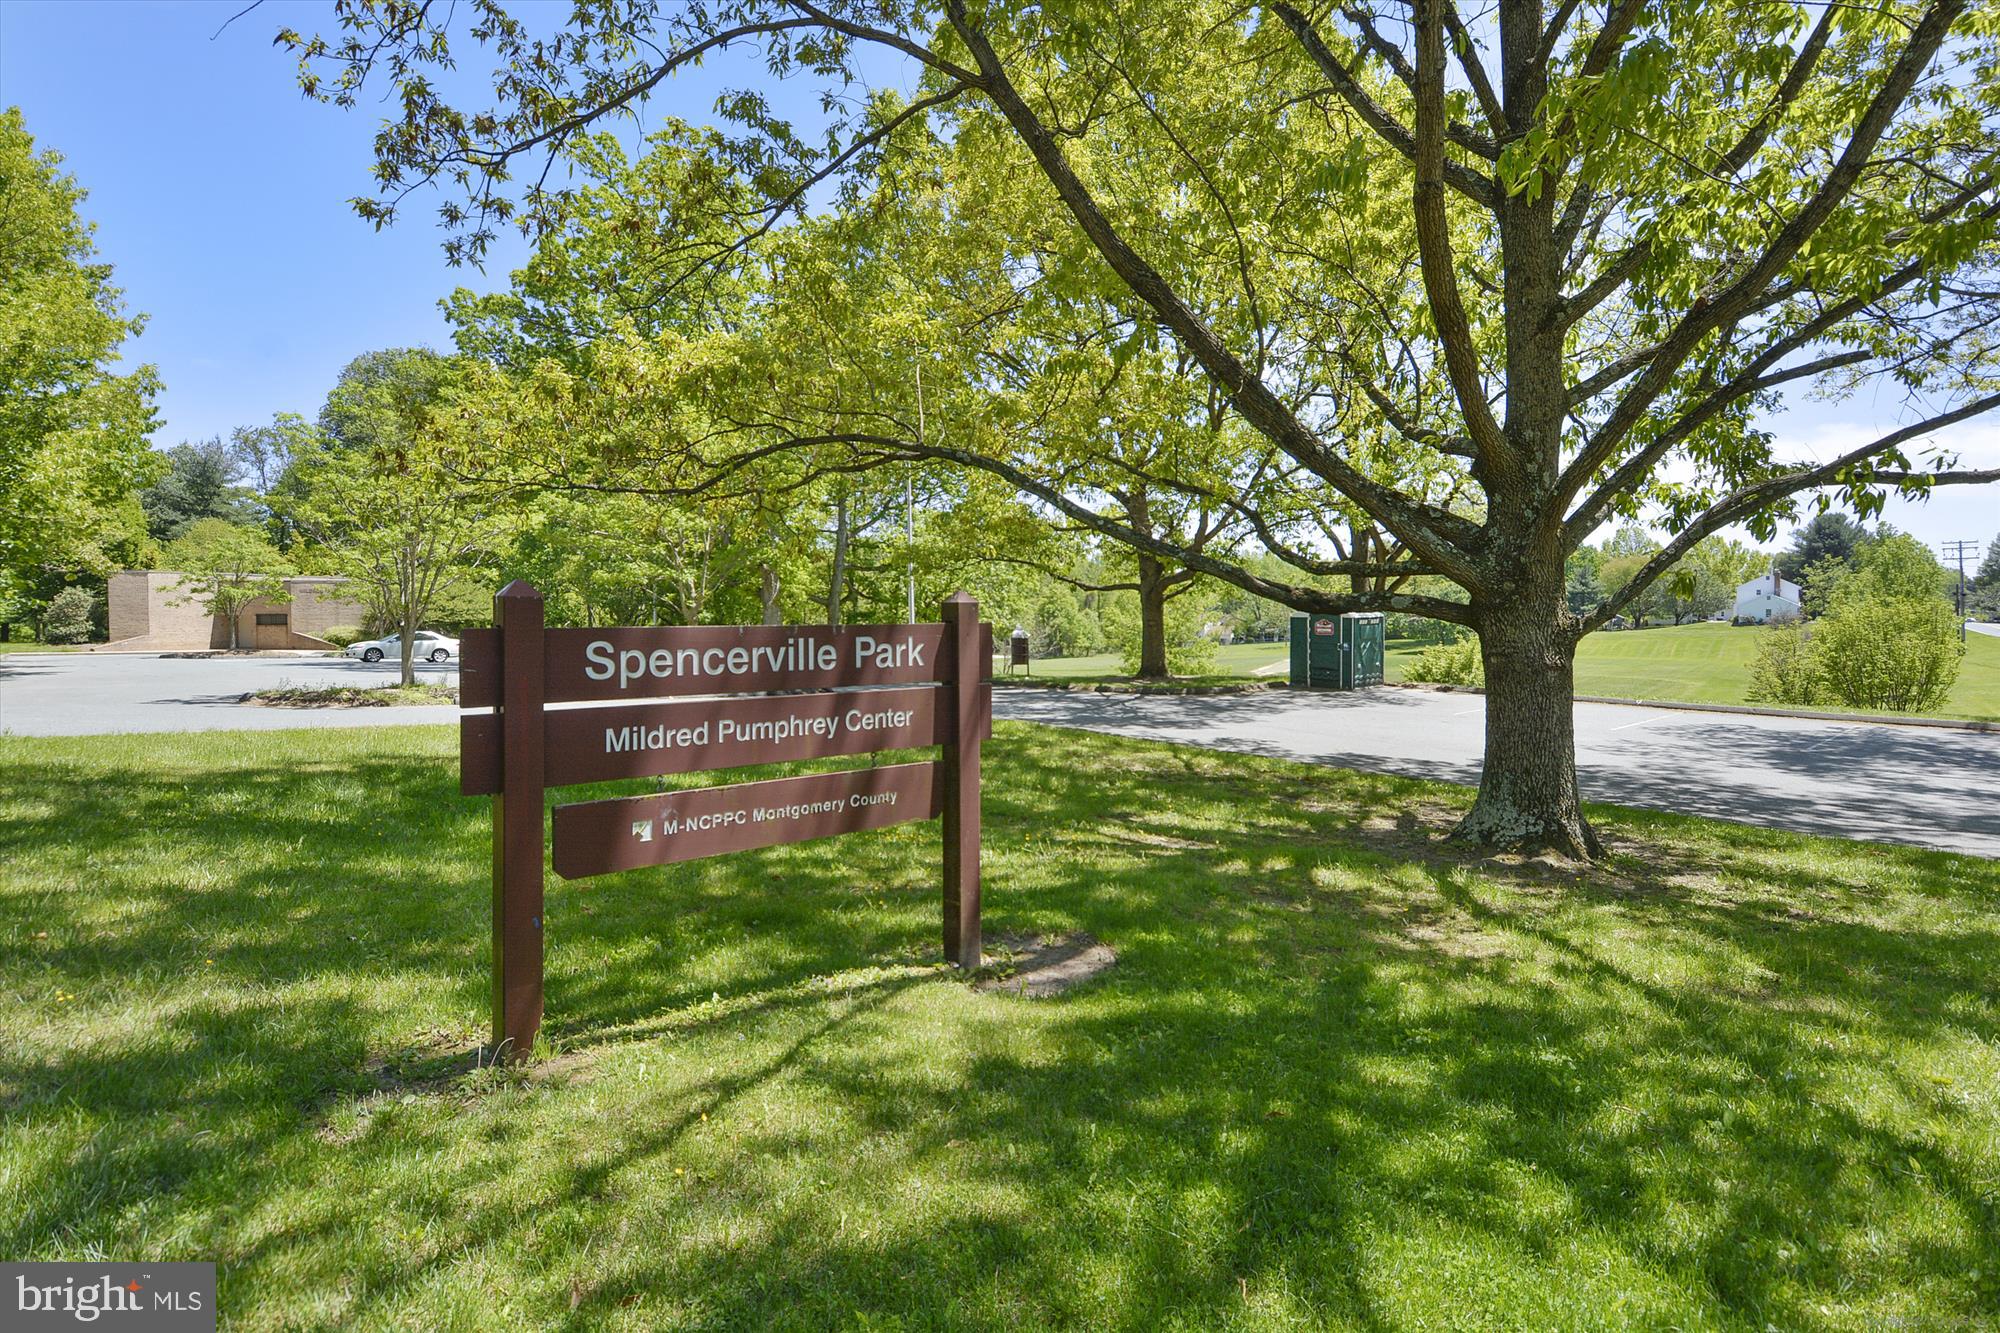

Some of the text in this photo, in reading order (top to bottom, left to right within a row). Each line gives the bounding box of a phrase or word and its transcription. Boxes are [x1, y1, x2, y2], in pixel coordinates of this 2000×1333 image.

[585, 636, 925, 689] Spencerville Park
[605, 708, 914, 753] Mildred Pumphrey Center
[663, 791, 897, 836] M-NCPPC Montgomery County
